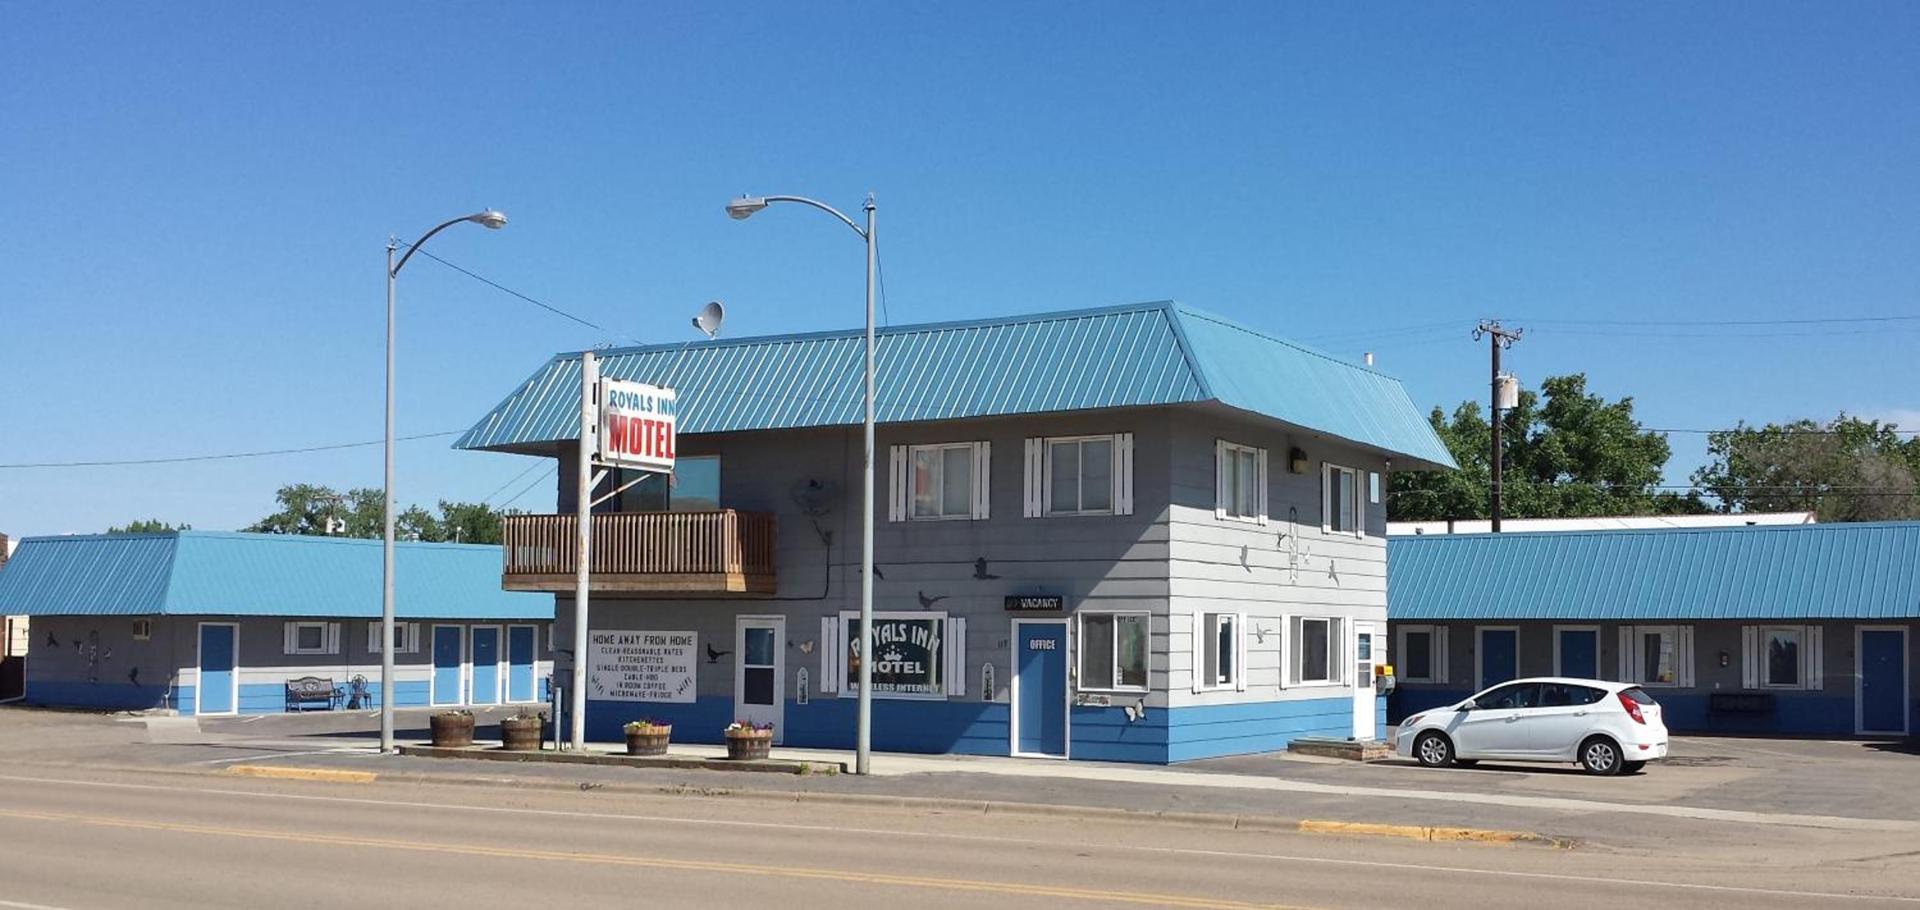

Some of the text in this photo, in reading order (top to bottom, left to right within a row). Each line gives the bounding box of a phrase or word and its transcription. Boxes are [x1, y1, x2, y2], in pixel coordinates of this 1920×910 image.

[609, 390, 675, 416] ROYALS INN
[609, 413, 674, 459] MOTEL
[1021, 598, 1058, 608] VACANCY
[593, 634, 693, 646] HOME AWAY FROM HOME
[911, 626, 940, 651] INN
[1029, 639, 1056, 650] OFFICE
[664, 648, 683, 656] RATES
